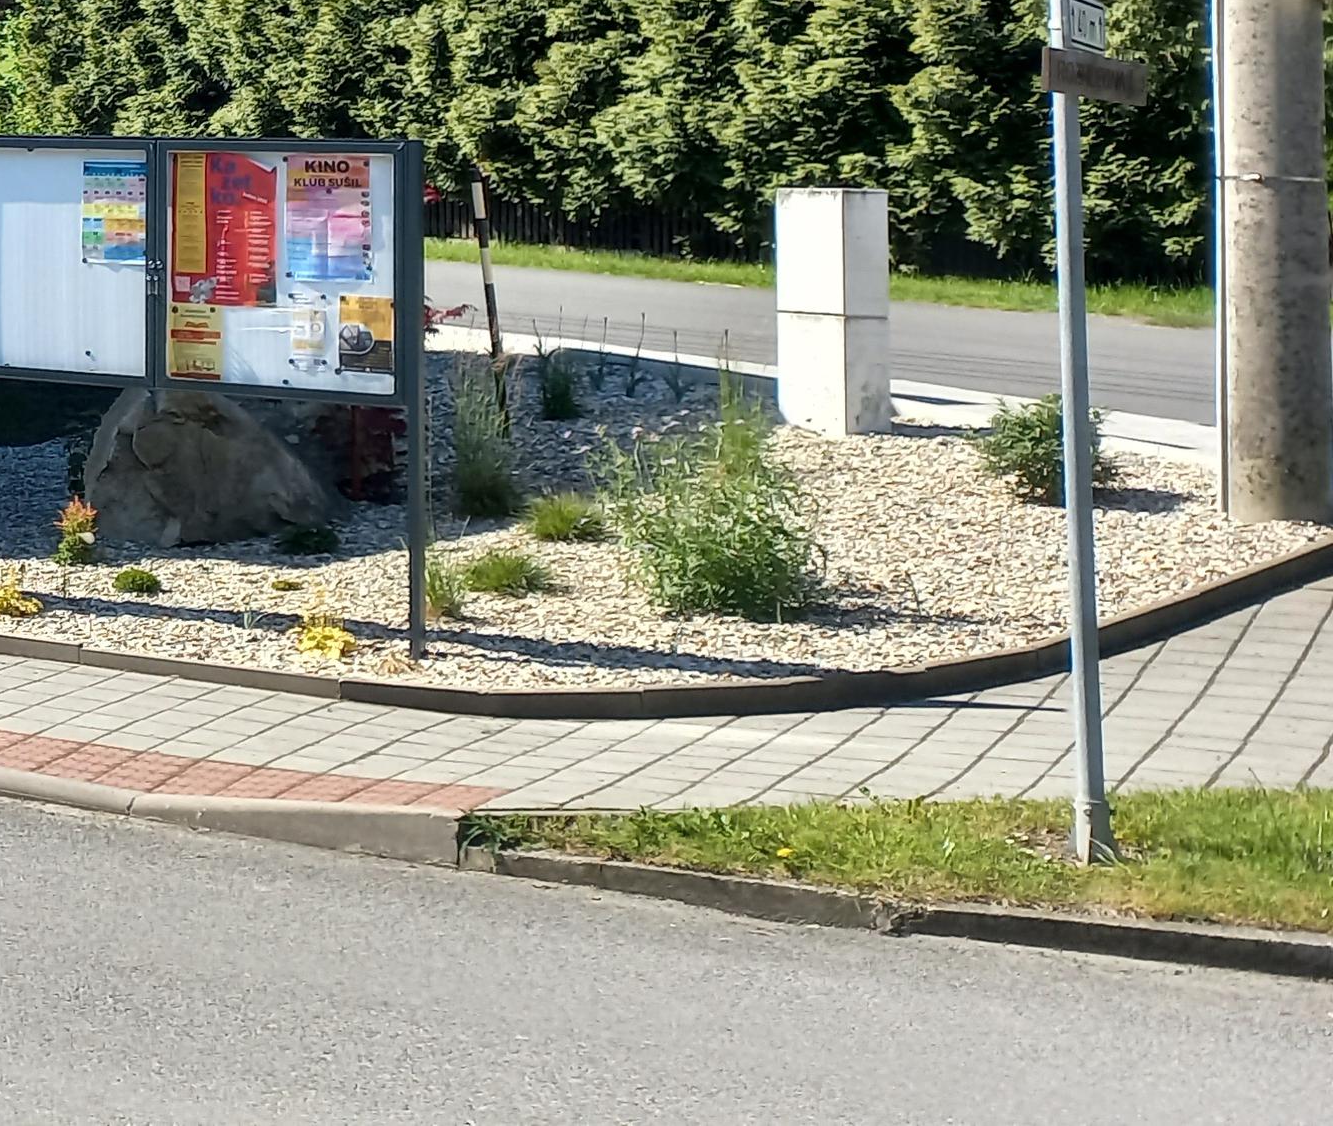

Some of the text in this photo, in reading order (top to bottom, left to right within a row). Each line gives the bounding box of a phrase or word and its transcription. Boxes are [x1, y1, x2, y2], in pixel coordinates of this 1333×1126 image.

[304, 160, 350, 173] KINO
[294, 177, 362, 188] KLUB SUŠIL
